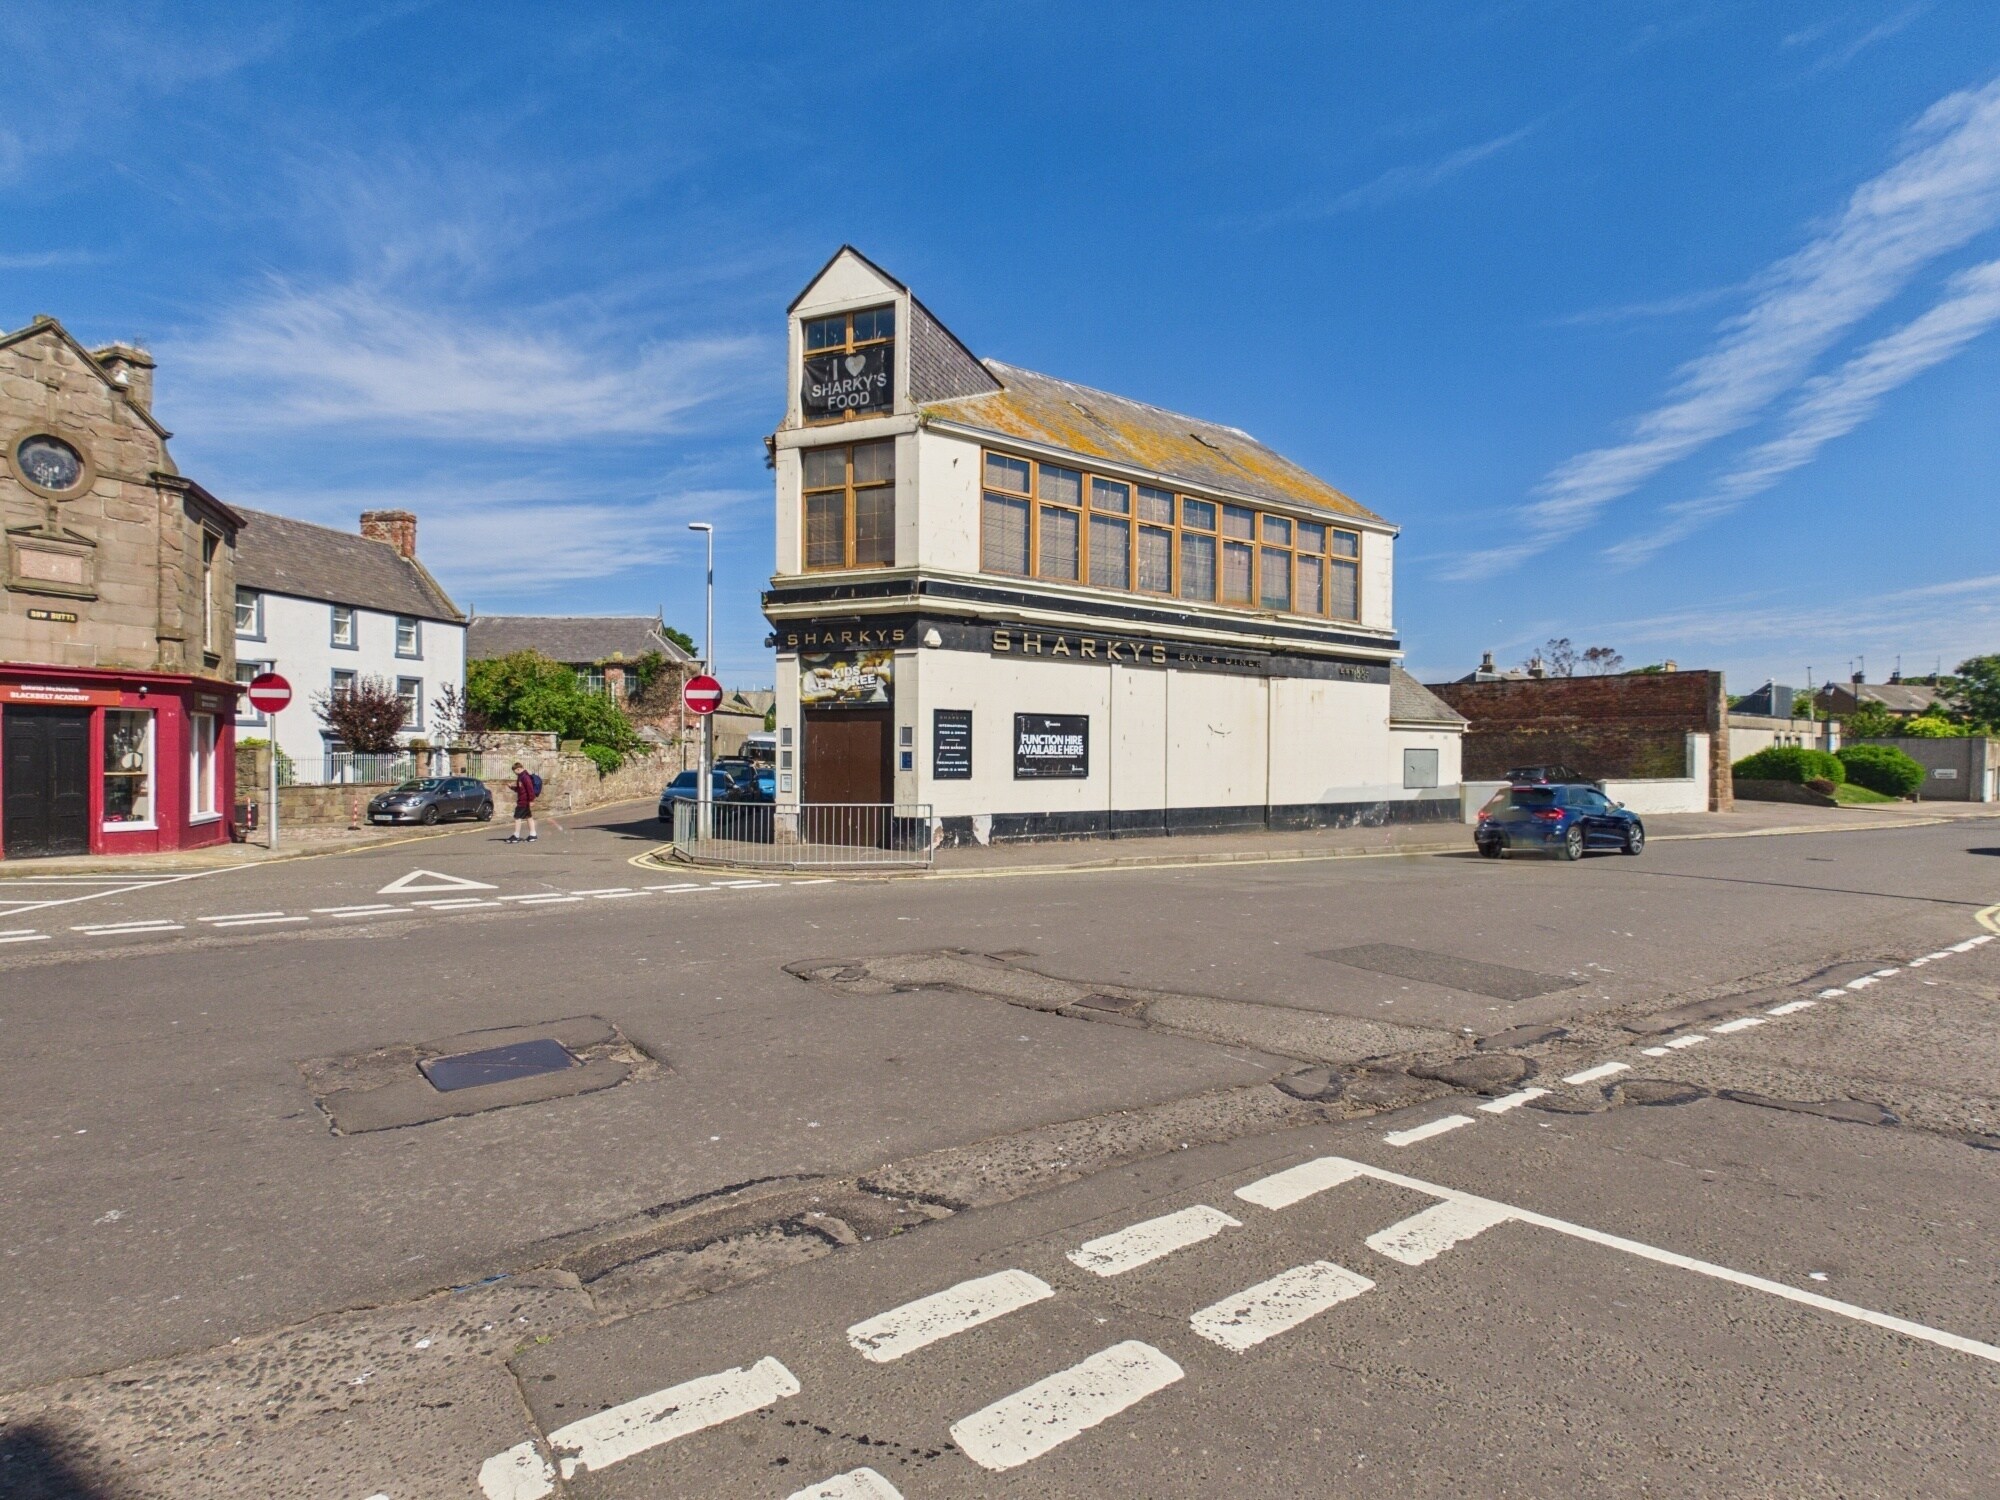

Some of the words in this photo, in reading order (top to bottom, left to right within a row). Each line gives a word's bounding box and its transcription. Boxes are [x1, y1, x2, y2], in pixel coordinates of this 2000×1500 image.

[832, 358, 839, 381] I
[811, 372, 887, 398] SHARKY'S
[827, 391, 870, 410] FOOD
[30, 610, 47, 618] BOW
[50, 612, 76, 621] BUTTS
[787, 629, 905, 646] SHARKYS
[992, 630, 1167, 664] SHARKYS
[1179, 652, 1204, 663] BAR
[1211, 655, 1218, 664] &
[1225, 656, 1263, 668] DINER
[831, 665, 861, 679] KIDS
[844, 673, 876, 688] FREE
[9, 691, 54, 700] BLACKBELT
[54, 693, 90, 702] ACADEMY
[1021, 734, 1064, 745] FUNCTION
[1064, 735, 1083, 745] HIRE
[1017, 744, 1063, 755] AVAILABLE
[1063, 745, 1084, 755] HERE
